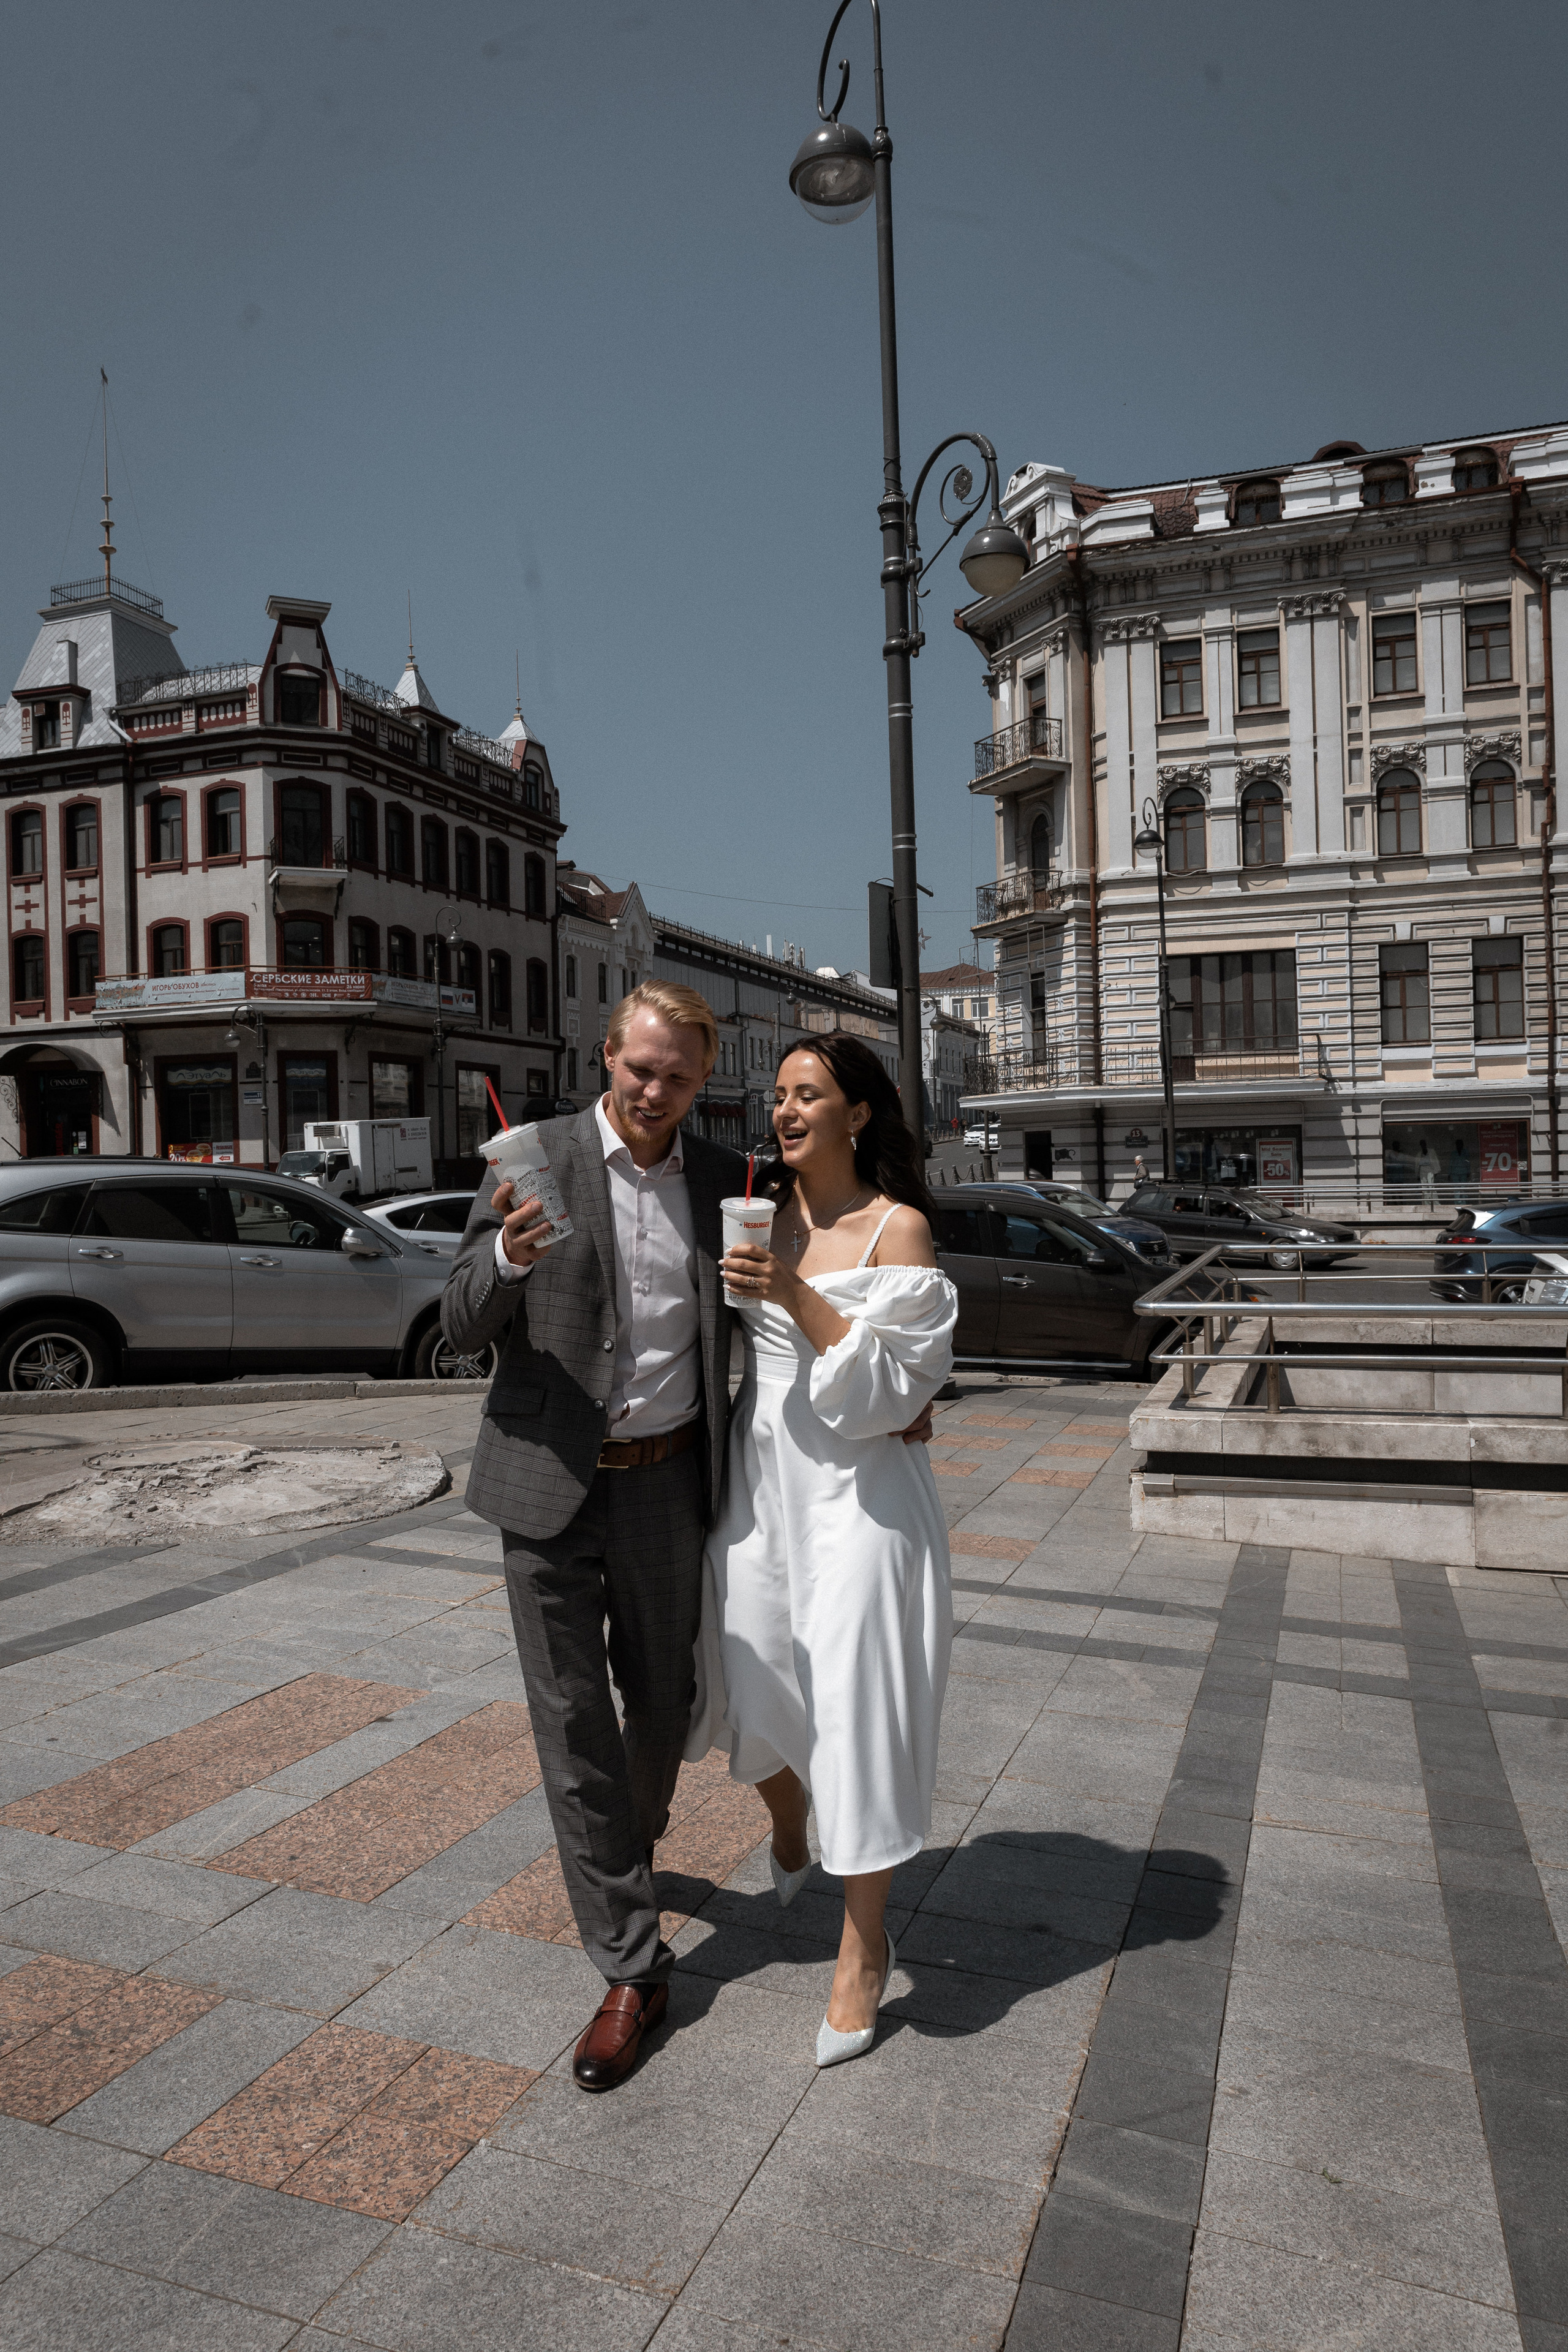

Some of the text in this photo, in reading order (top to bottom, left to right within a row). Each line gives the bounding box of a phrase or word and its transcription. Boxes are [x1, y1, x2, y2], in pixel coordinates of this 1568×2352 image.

[252, 973, 365, 984] СЕРБСКИЕ ЗАМЕТКИ
[50, 1078, 88, 1087] CINNABON
[1264, 1163, 1289, 1177] -50%
